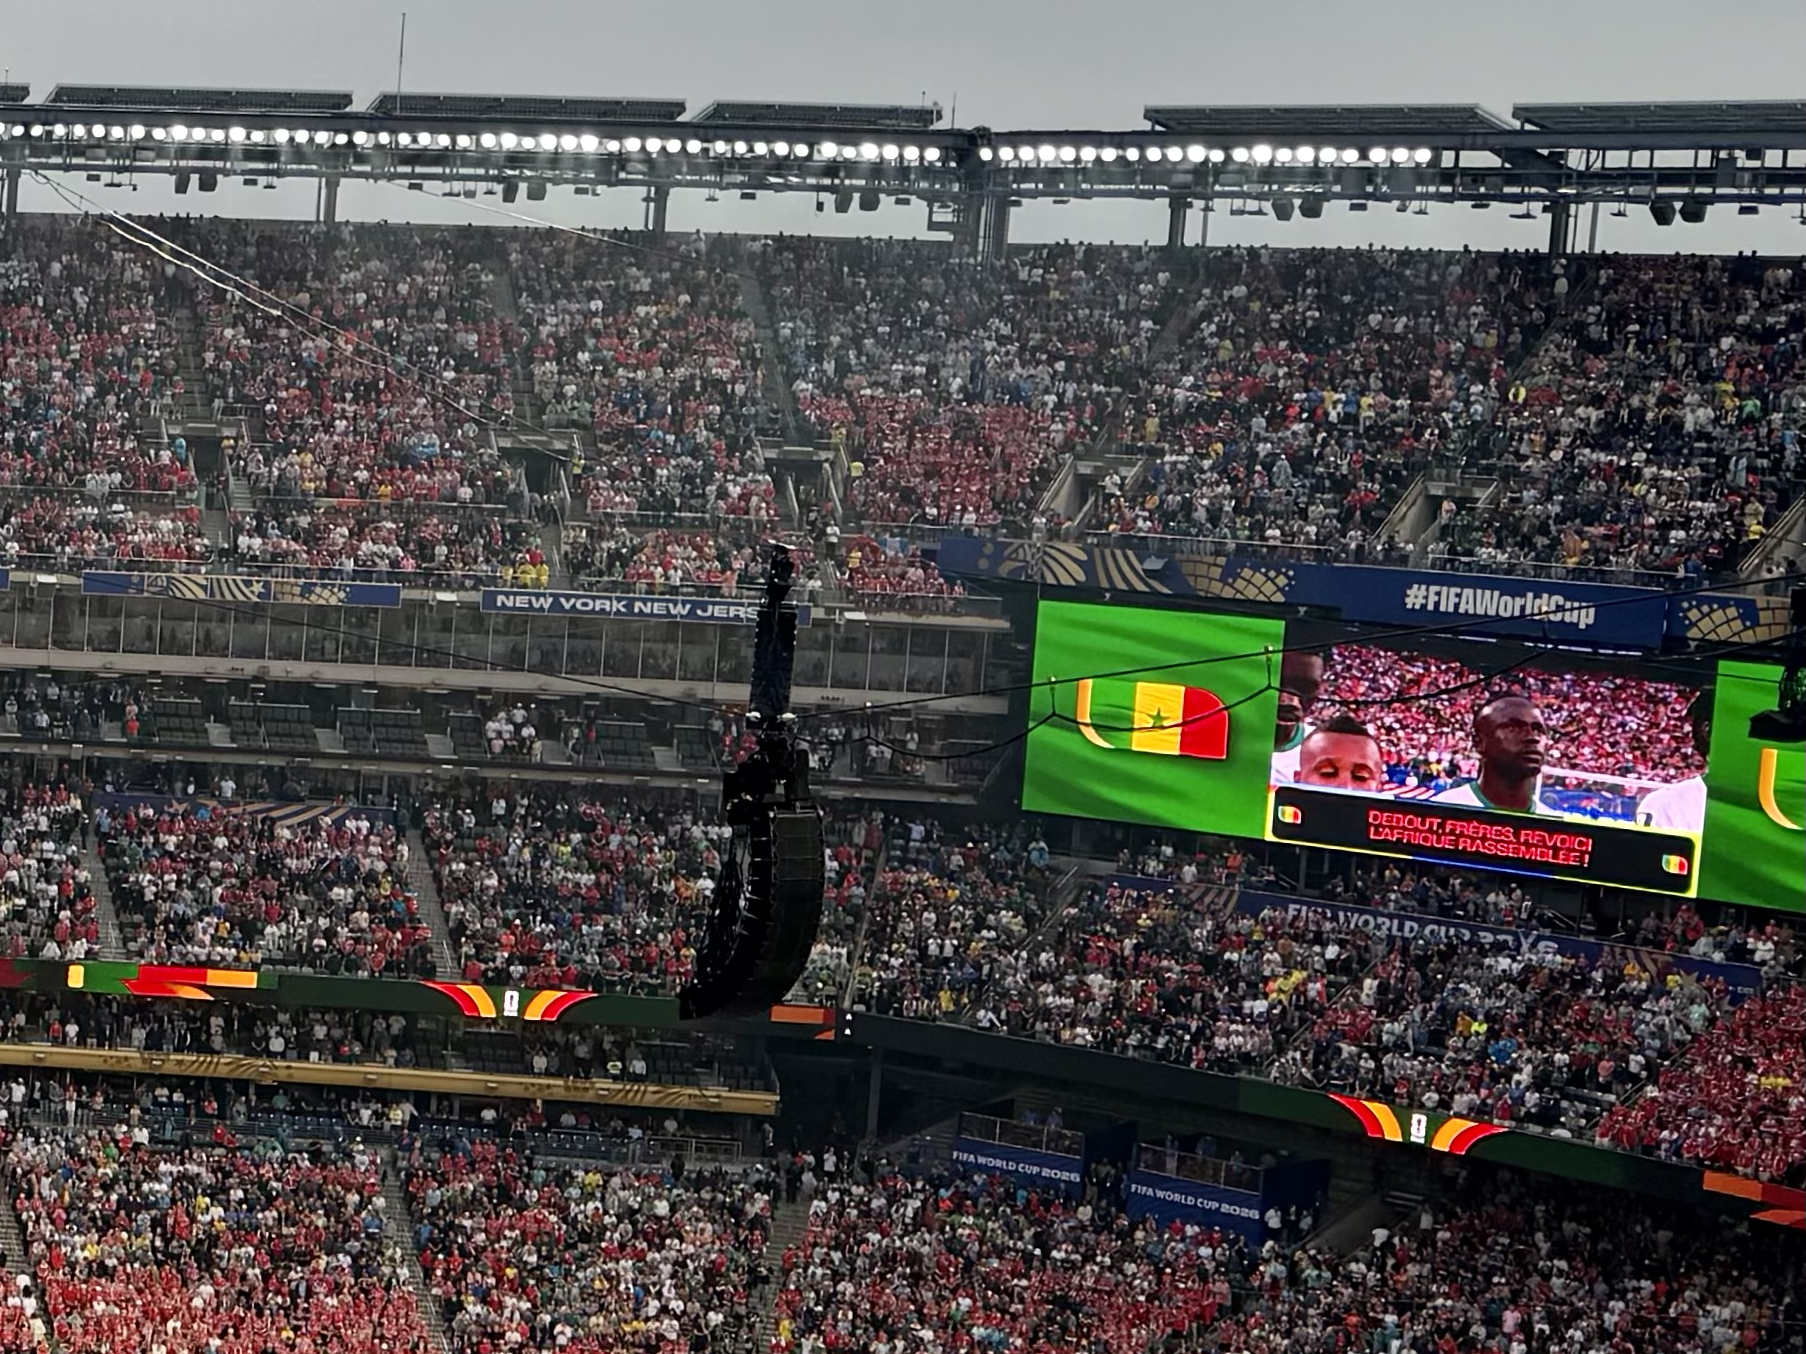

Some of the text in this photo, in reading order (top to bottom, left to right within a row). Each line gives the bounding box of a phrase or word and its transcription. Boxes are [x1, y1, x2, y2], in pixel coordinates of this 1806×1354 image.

[496, 594, 760, 620] NEW YORK NEW JERS
[1405, 583, 1596, 628] #FIFAWorldCup
[952, 1150, 1081, 1182] FIFA WORLD CUP 2026
[1130, 1183, 1260, 1220] FIFA WORLD CUP 2026
